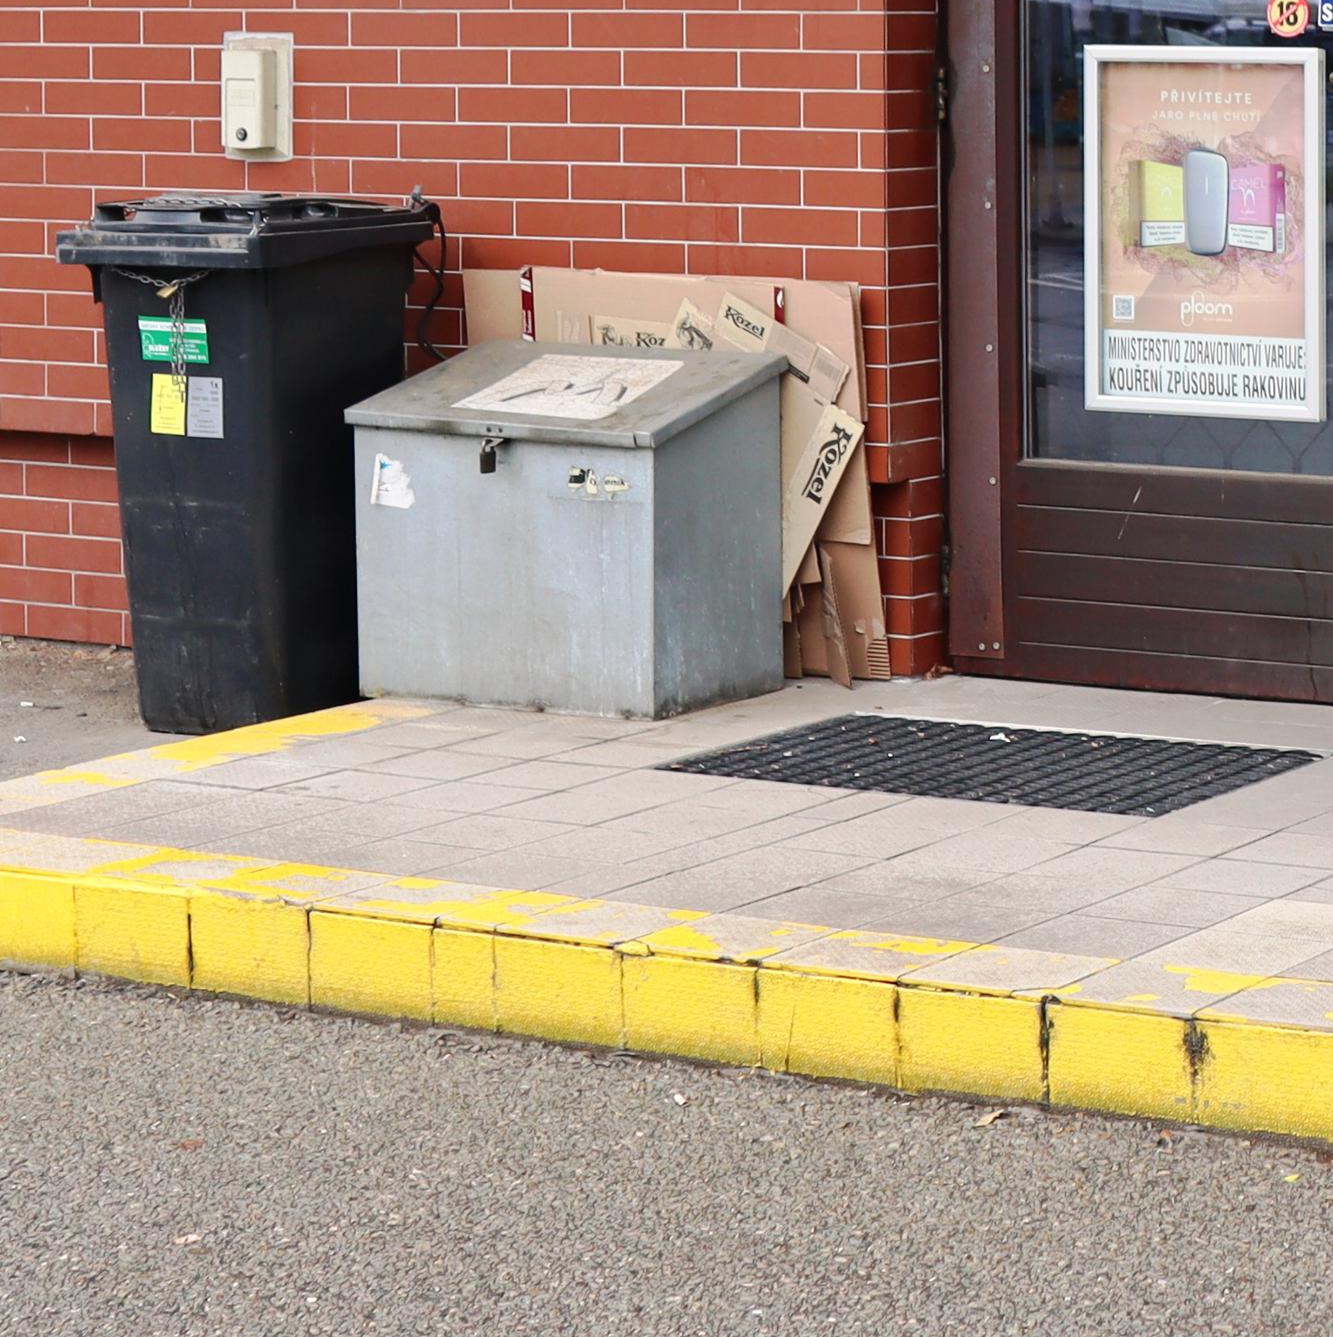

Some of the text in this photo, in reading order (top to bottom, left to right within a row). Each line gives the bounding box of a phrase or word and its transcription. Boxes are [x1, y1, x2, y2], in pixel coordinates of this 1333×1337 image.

[1160, 88, 1254, 105] PŘIVÍTEJTE
[723, 304, 766, 342] Kozel
[1180, 290, 1234, 328] ploom
[635, 330, 667, 349] Koz
[1108, 336, 1181, 363] MINISTERSTVO
[1184, 339, 1262, 366] ZDRAVOTNICTVÍ
[1108, 365, 1307, 401] KOUŘENÍ ZPŮSOBUJE RAKOVINU
[800, 422, 854, 505] Kozel
